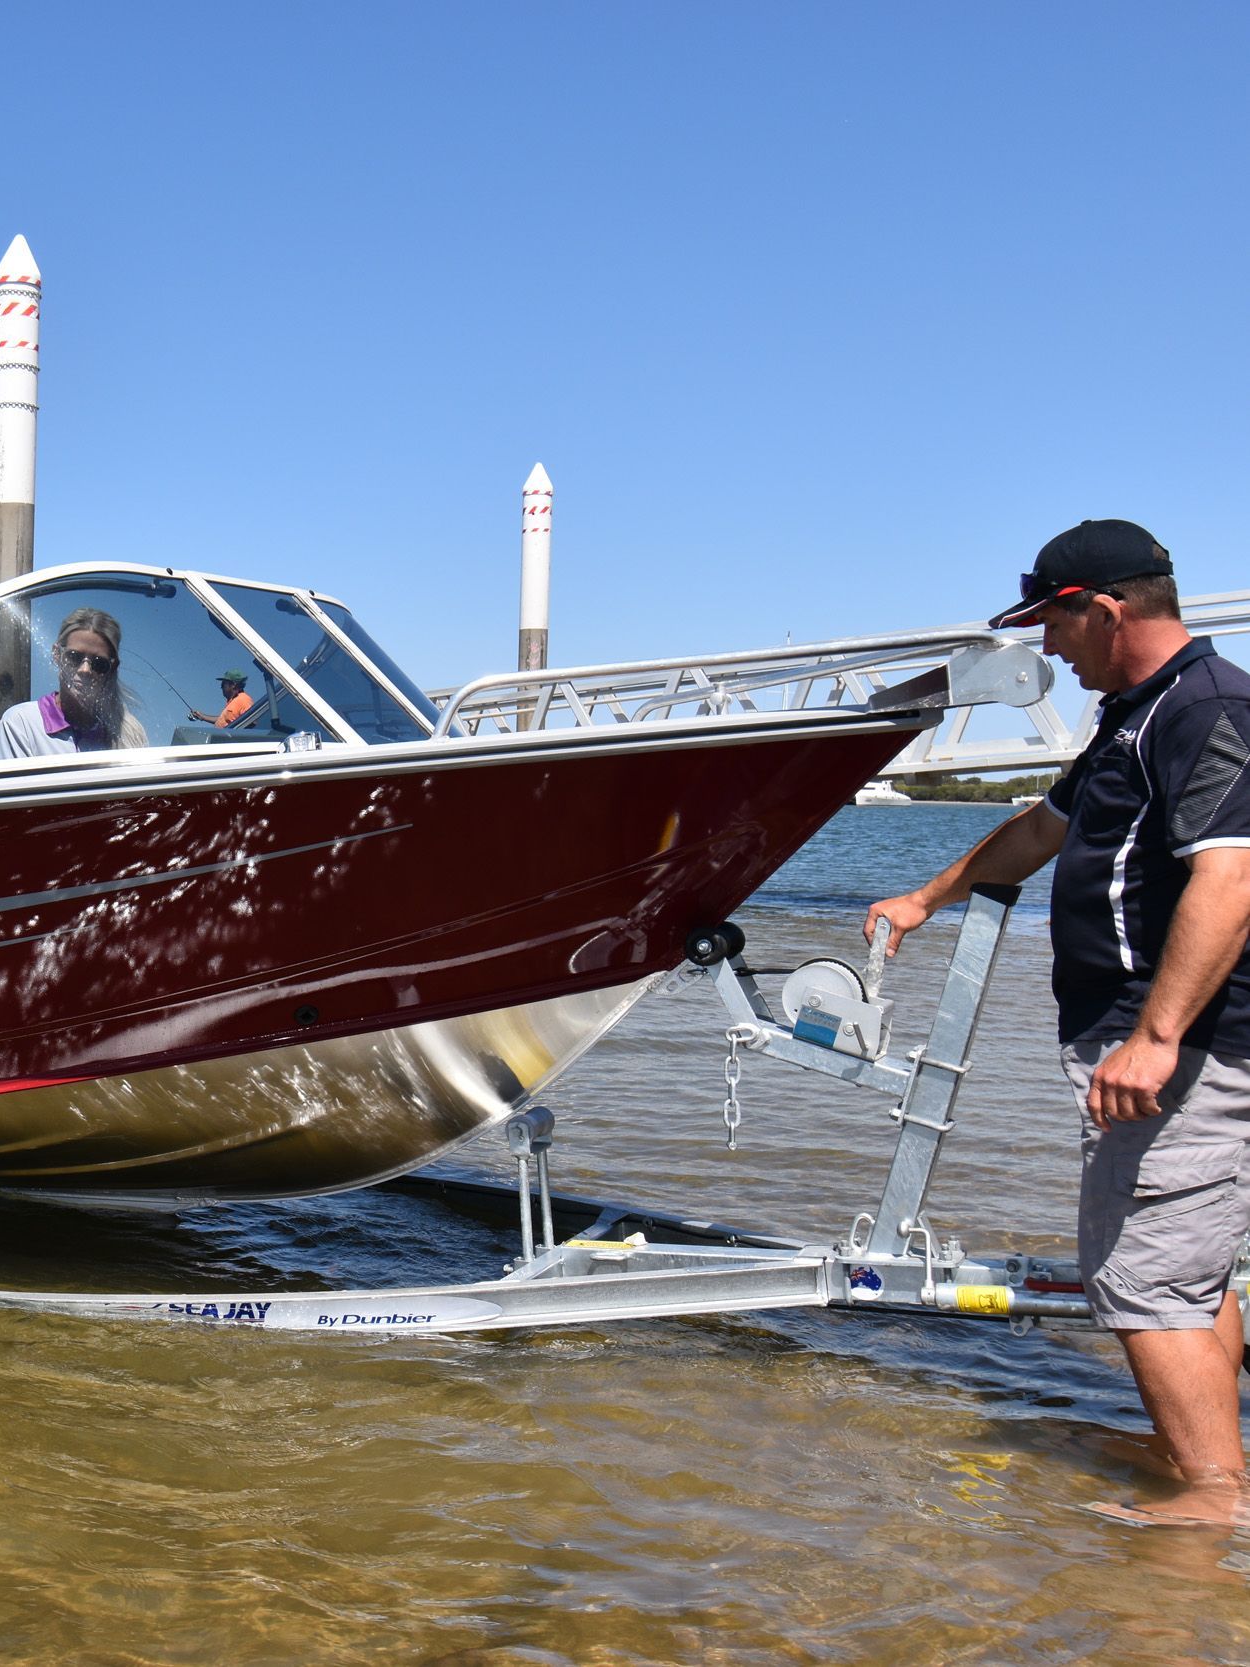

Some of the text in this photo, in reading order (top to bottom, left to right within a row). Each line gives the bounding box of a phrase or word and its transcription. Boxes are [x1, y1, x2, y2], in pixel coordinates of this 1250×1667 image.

[223, 1302, 272, 1319] JAY
[317, 1313, 437, 1327] By Dunbier
